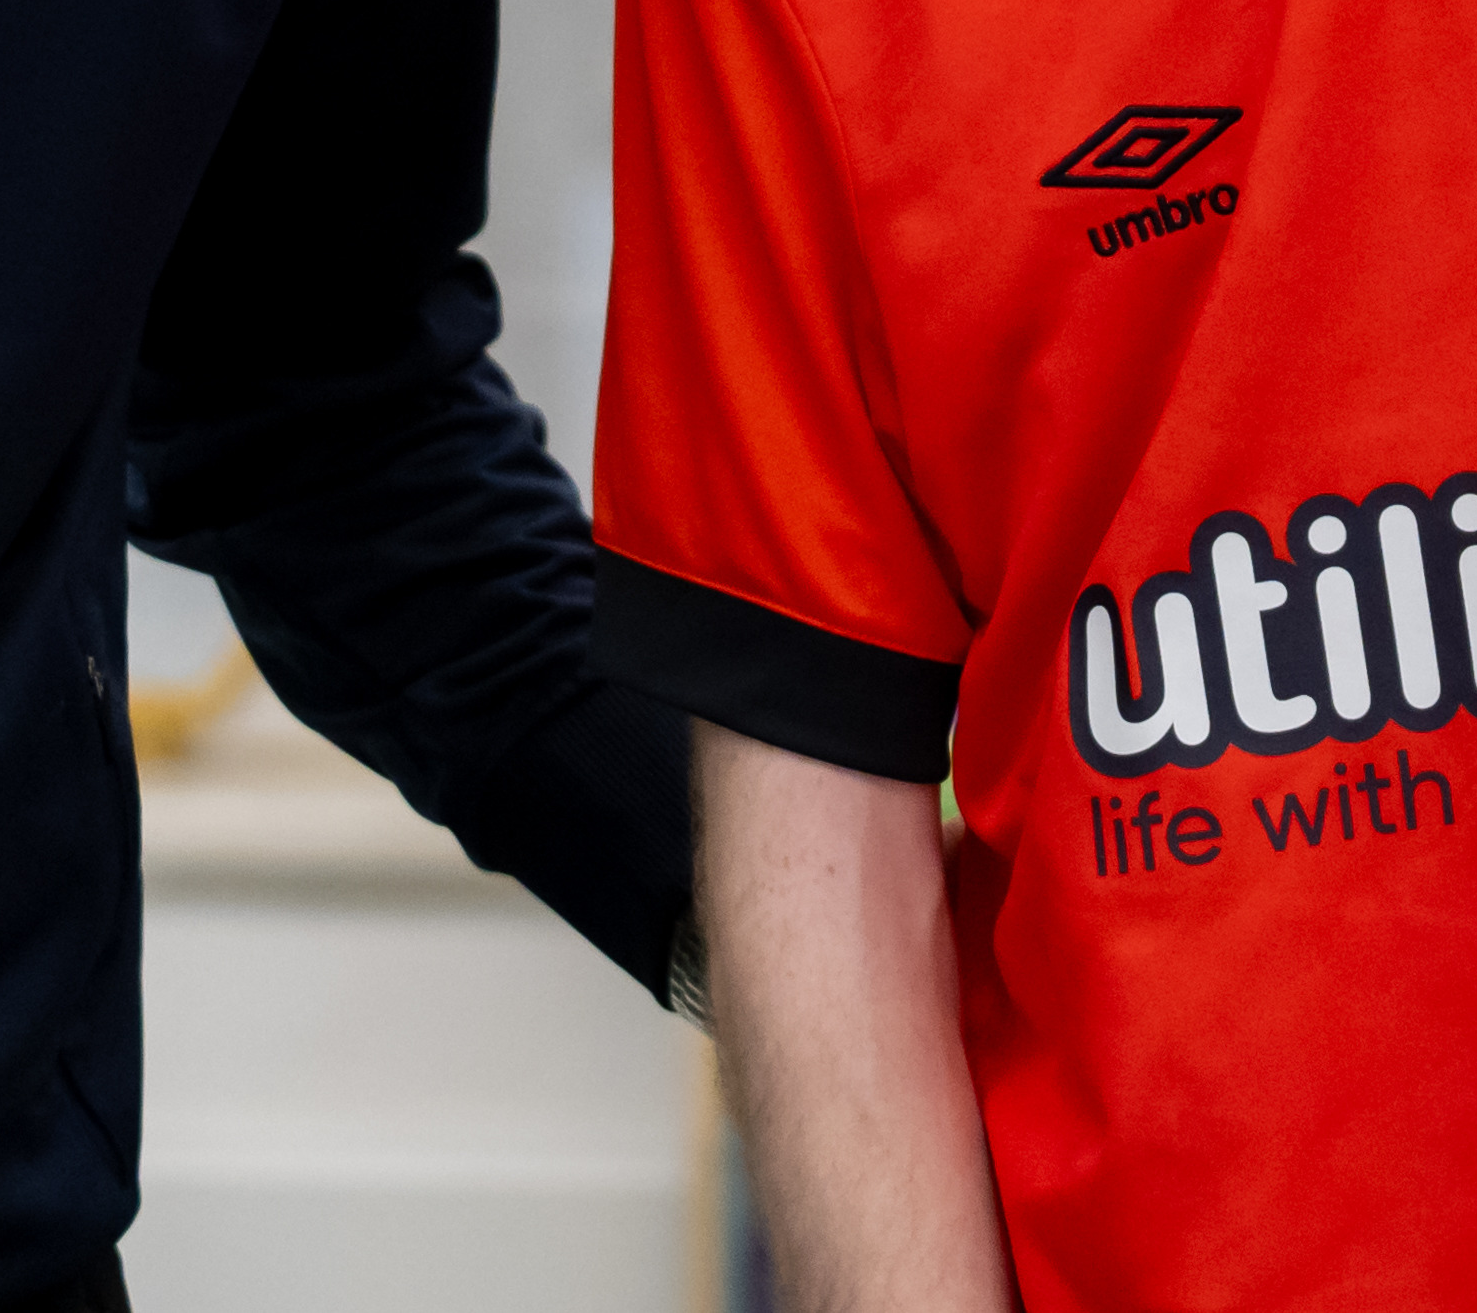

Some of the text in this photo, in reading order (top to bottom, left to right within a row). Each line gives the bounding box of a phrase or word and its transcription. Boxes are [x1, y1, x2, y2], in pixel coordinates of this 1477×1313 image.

[1087, 183, 1239, 257] umbro
[1090, 790, 1223, 877] life
[1252, 749, 1455, 853] with
